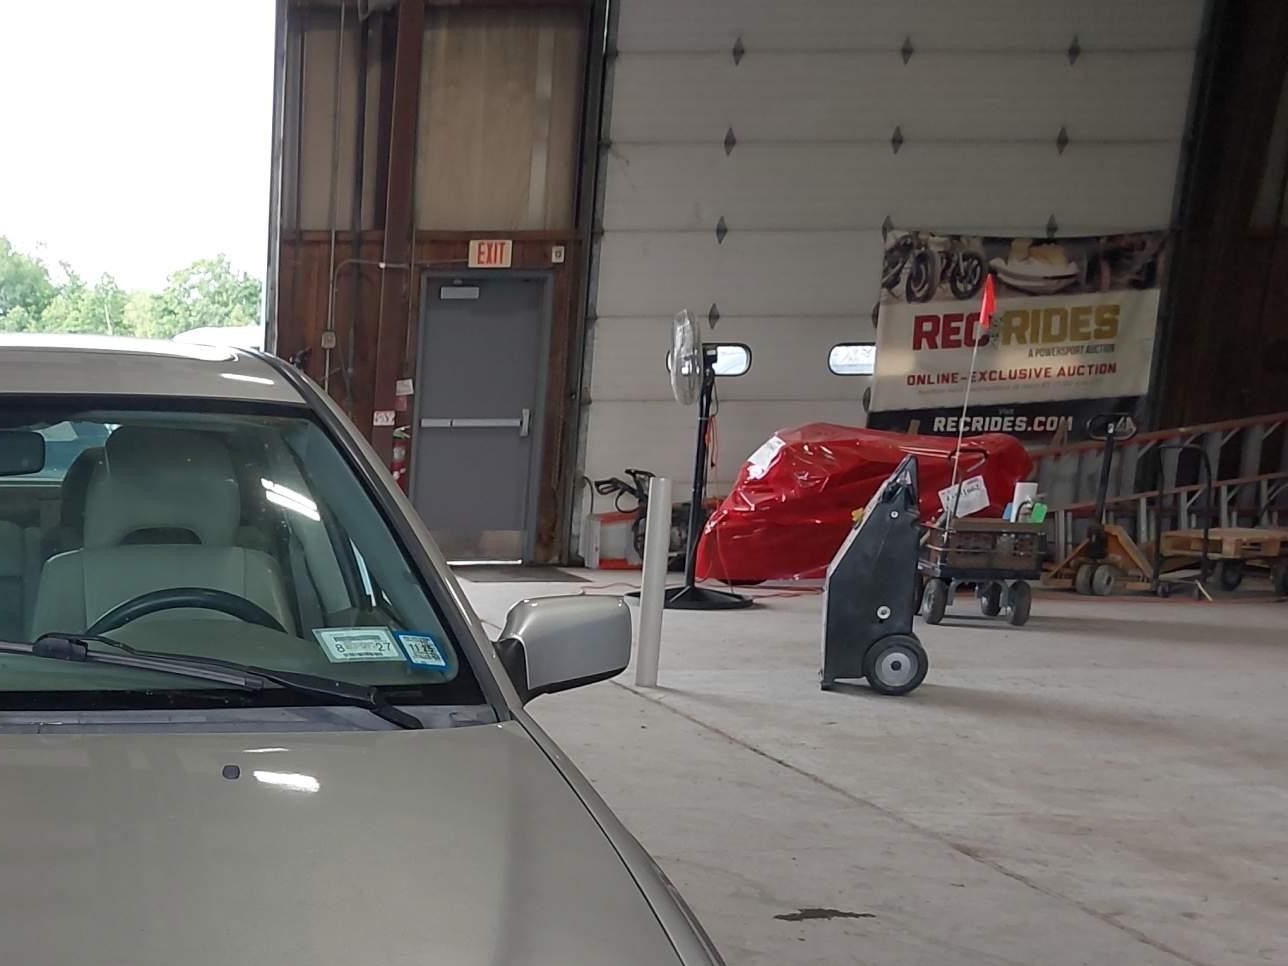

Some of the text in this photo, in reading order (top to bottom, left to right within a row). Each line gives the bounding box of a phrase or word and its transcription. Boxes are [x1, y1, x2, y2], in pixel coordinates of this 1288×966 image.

[477, 242, 505, 265] EXIT
[1001, 304, 1121, 345] RIDES
[907, 367, 1052, 386] ONLINE-EXCLUSIVE
[1057, 362, 1117, 377] AUCTION
[933, 416, 1073, 432] RECRIDES.COM
[375, 642, 391, 652] 27
